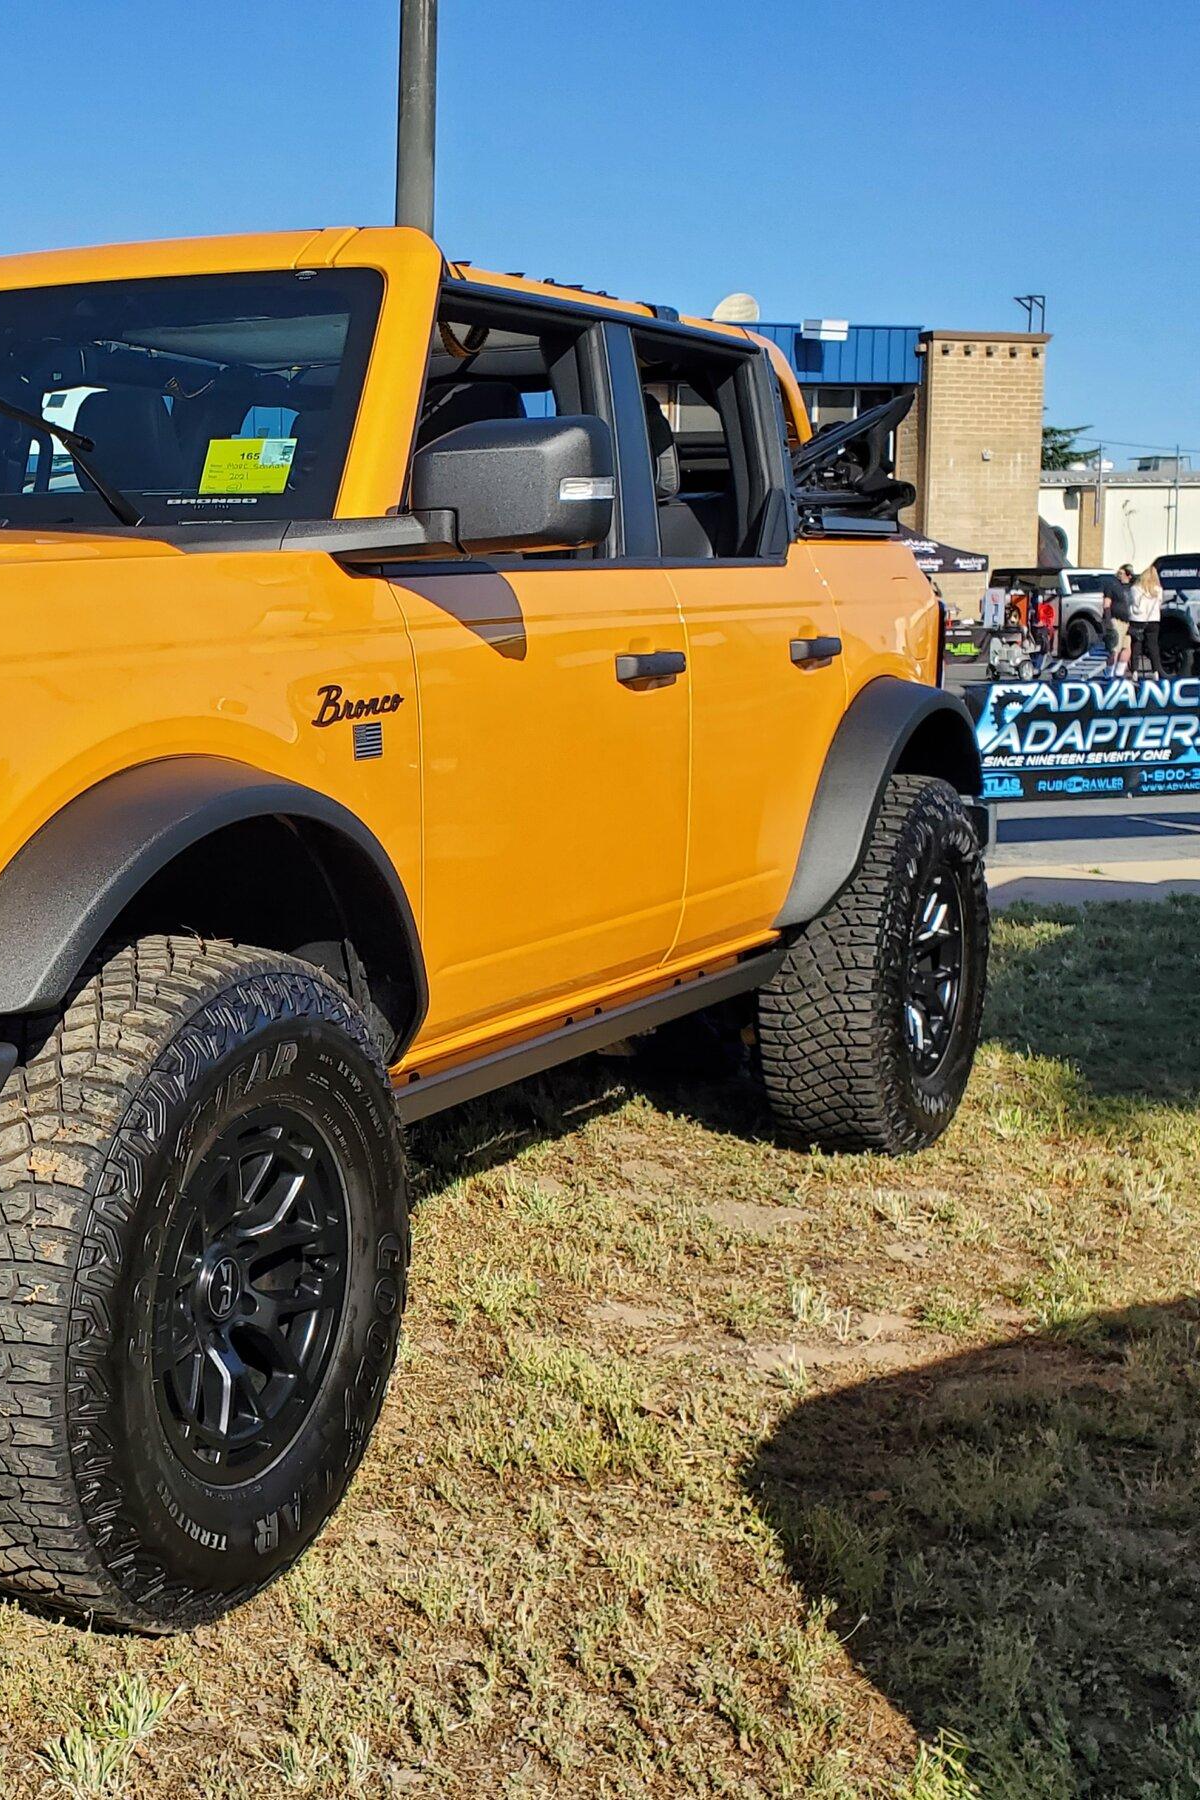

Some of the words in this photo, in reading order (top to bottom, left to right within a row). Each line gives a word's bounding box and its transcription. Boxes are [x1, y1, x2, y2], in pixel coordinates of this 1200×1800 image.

[240, 452, 260, 460] 165
[311, 685, 404, 727] Bronco
[1022, 678, 1200, 713] ADVANC
[982, 715, 1200, 753] ADAPTER
[981, 755, 1025, 767] SINCE
[1025, 752, 1086, 767] NINETEEN
[1086, 750, 1141, 764] SEVENTY
[1142, 748, 1172, 761] ONE
[983, 777, 1021, 792] TLAS
